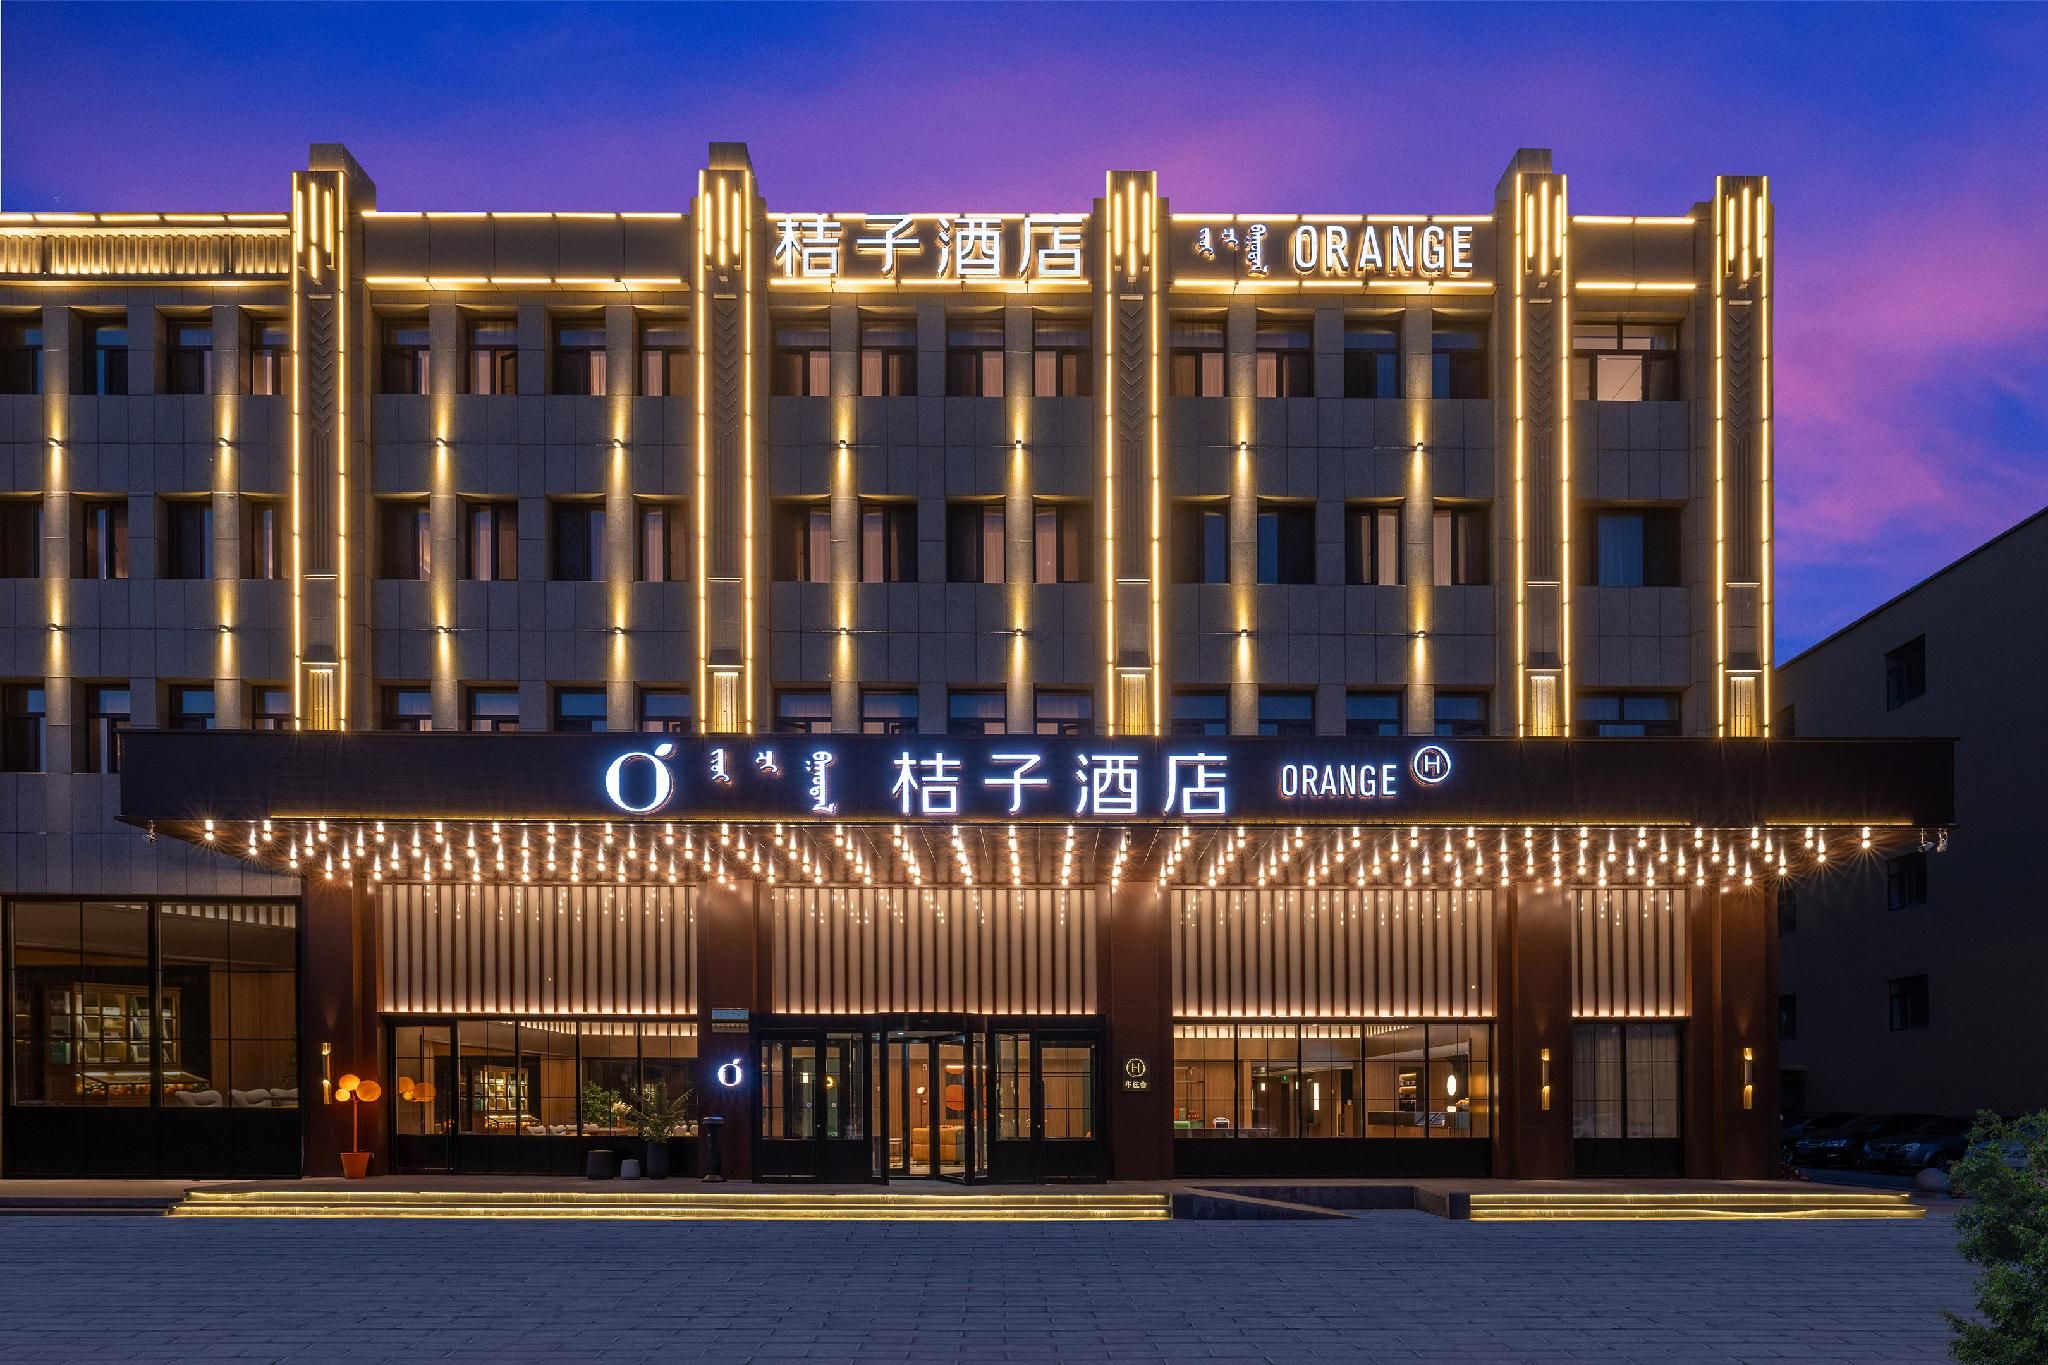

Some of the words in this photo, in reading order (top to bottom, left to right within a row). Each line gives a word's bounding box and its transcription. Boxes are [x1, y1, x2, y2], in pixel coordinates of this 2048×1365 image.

[775, 214, 1083, 278] 桔子酒店
[1295, 225, 1473, 269] ORANGE
[892, 752, 1228, 814] 桔子酒店
[1282, 764, 1397, 796] ORANGE
